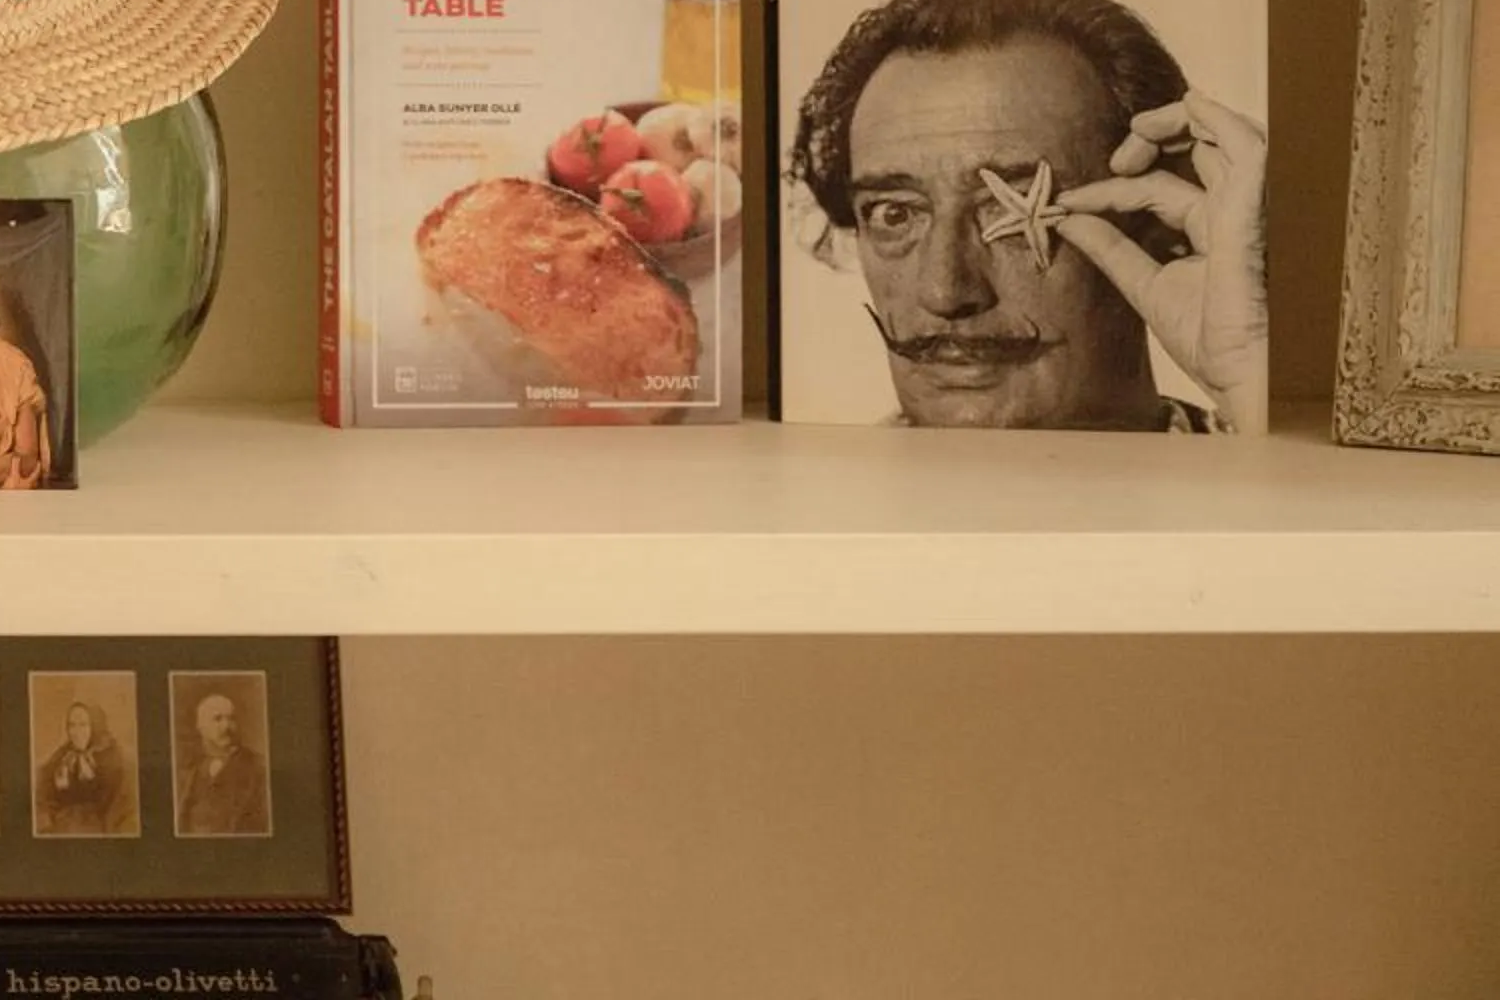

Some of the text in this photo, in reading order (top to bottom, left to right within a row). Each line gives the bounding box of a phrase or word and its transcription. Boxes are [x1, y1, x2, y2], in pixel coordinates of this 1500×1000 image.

[323, 88, 333, 239] CATALAN
[323, 247, 333, 312] THE
[643, 375, 699, 391] JOVIAT
[5, 967, 278, 1000] hispano-olivetti
